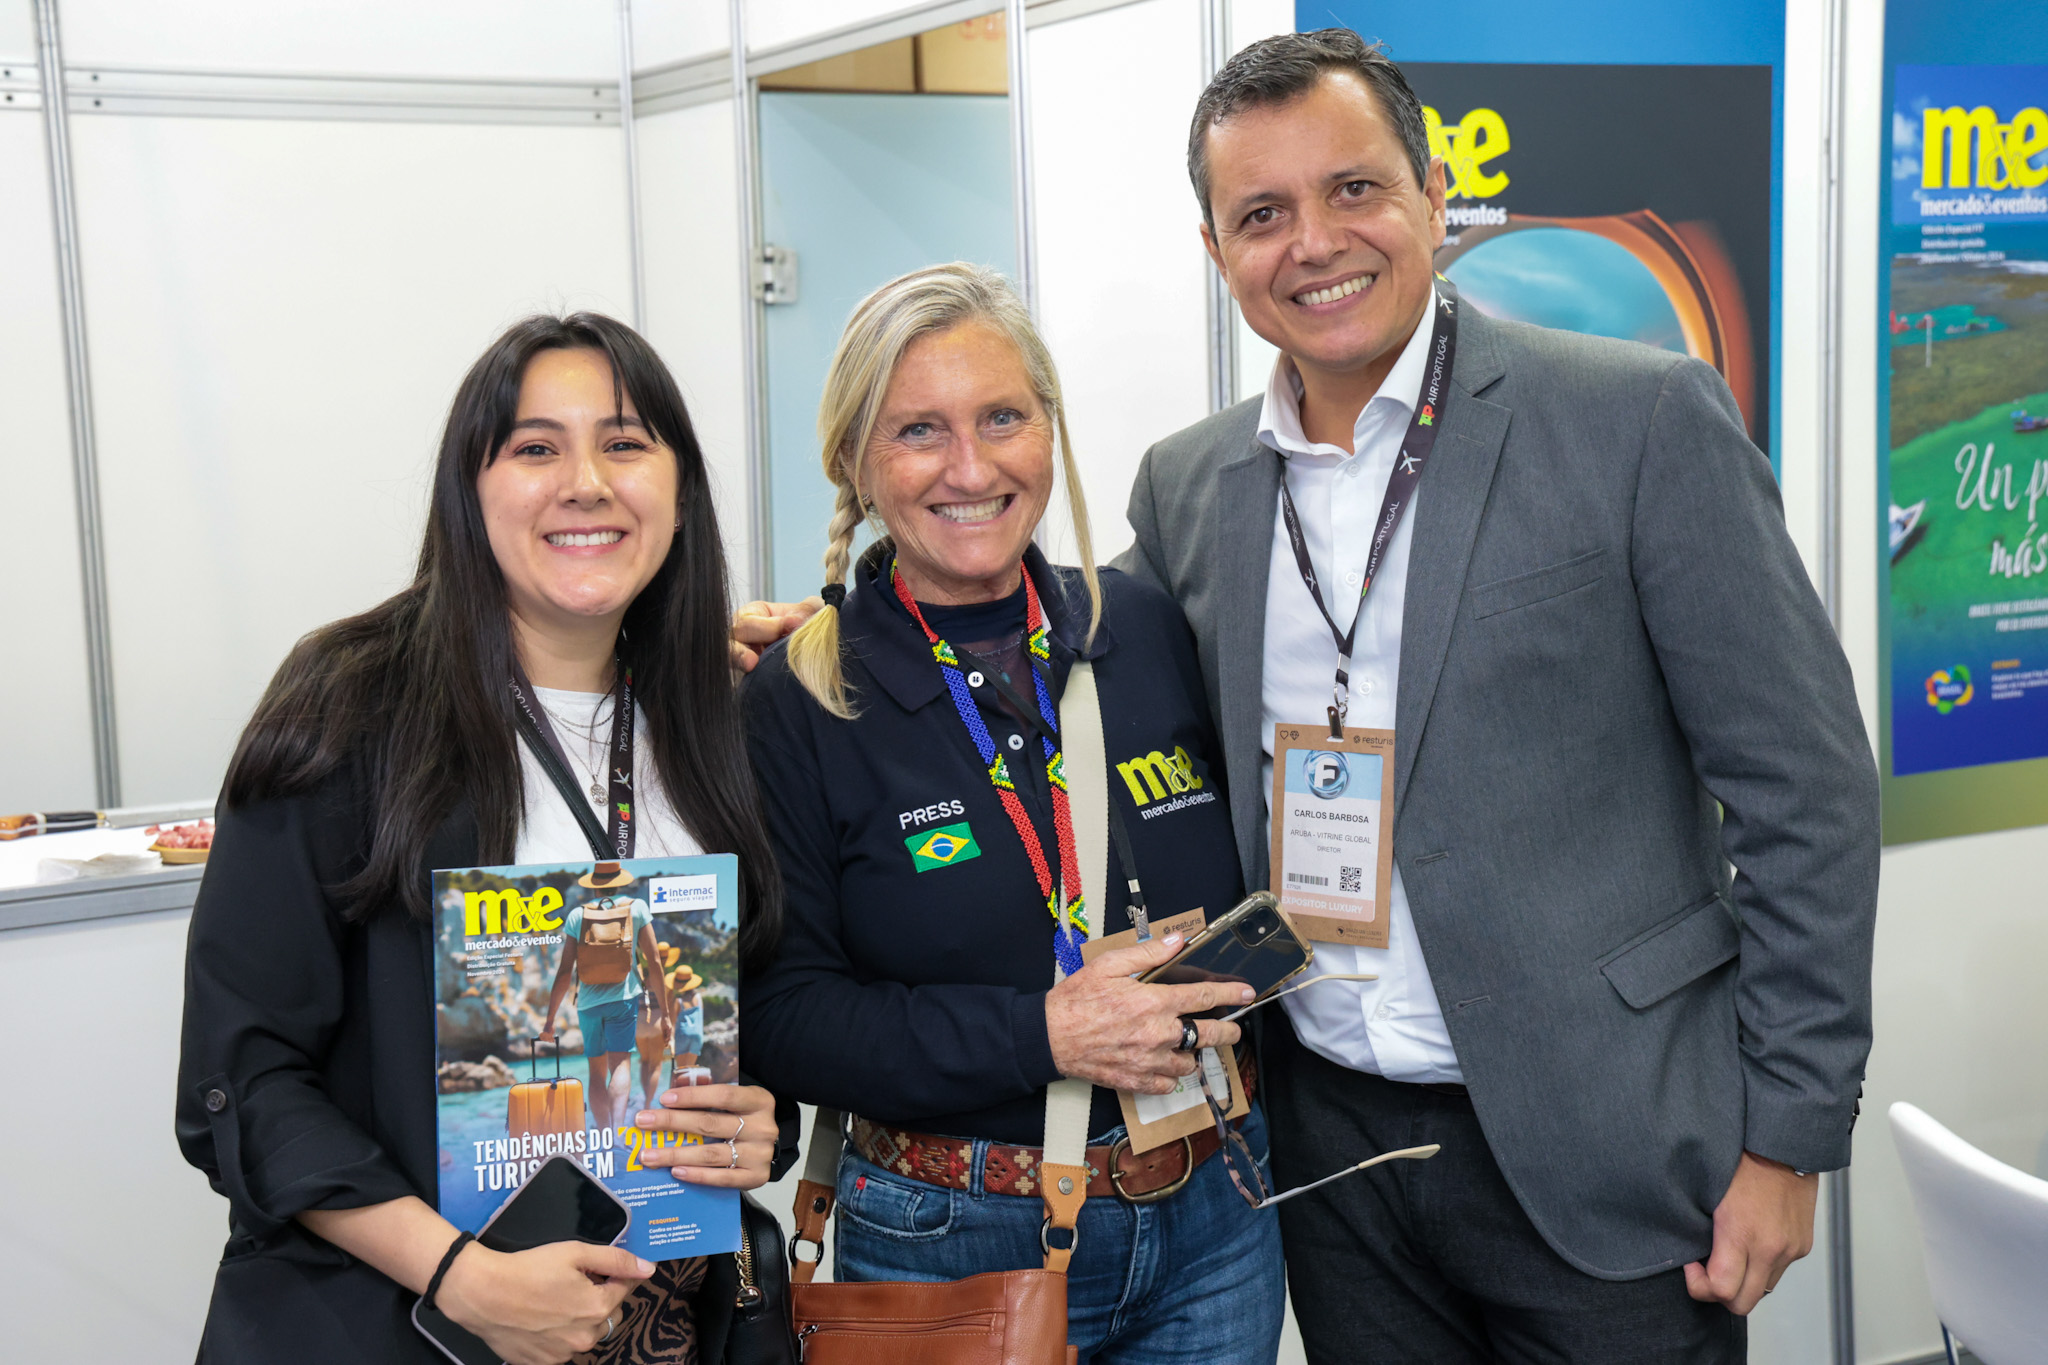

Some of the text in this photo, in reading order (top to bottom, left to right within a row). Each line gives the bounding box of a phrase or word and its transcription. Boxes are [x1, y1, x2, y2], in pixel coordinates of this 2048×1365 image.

[1422, 106, 1510, 199] &e
[1921, 106, 2048, 190] m&e
[1445, 203, 1508, 225] eventos
[1955, 442, 2022, 512] Un
[1116, 746, 1203, 806] m&e
[899, 800, 965, 830] PRESS
[1294, 809, 1369, 823] CARLOS BARBOSA
[1291, 829, 1312, 838] ARUBA
[1317, 832, 1343, 841] VITRINE
[1345, 835, 1371, 844] GLOBAL
[669, 887, 713, 896] intermac
[464, 887, 564, 936] m&e
[1282, 896, 1363, 914] EXPOSITOR LUXURY
[465, 934, 562, 951] mercado&eventos
[473, 1131, 586, 1163] TENDÊNCIAS
[589, 1127, 613, 1151] DO
[474, 1159, 541, 1192] TURIS
[620, 1192, 651, 1200] onalizados
[642, 1183, 680, 1192] protagonistas
[648, 1217, 679, 1225] PESQUISAS
